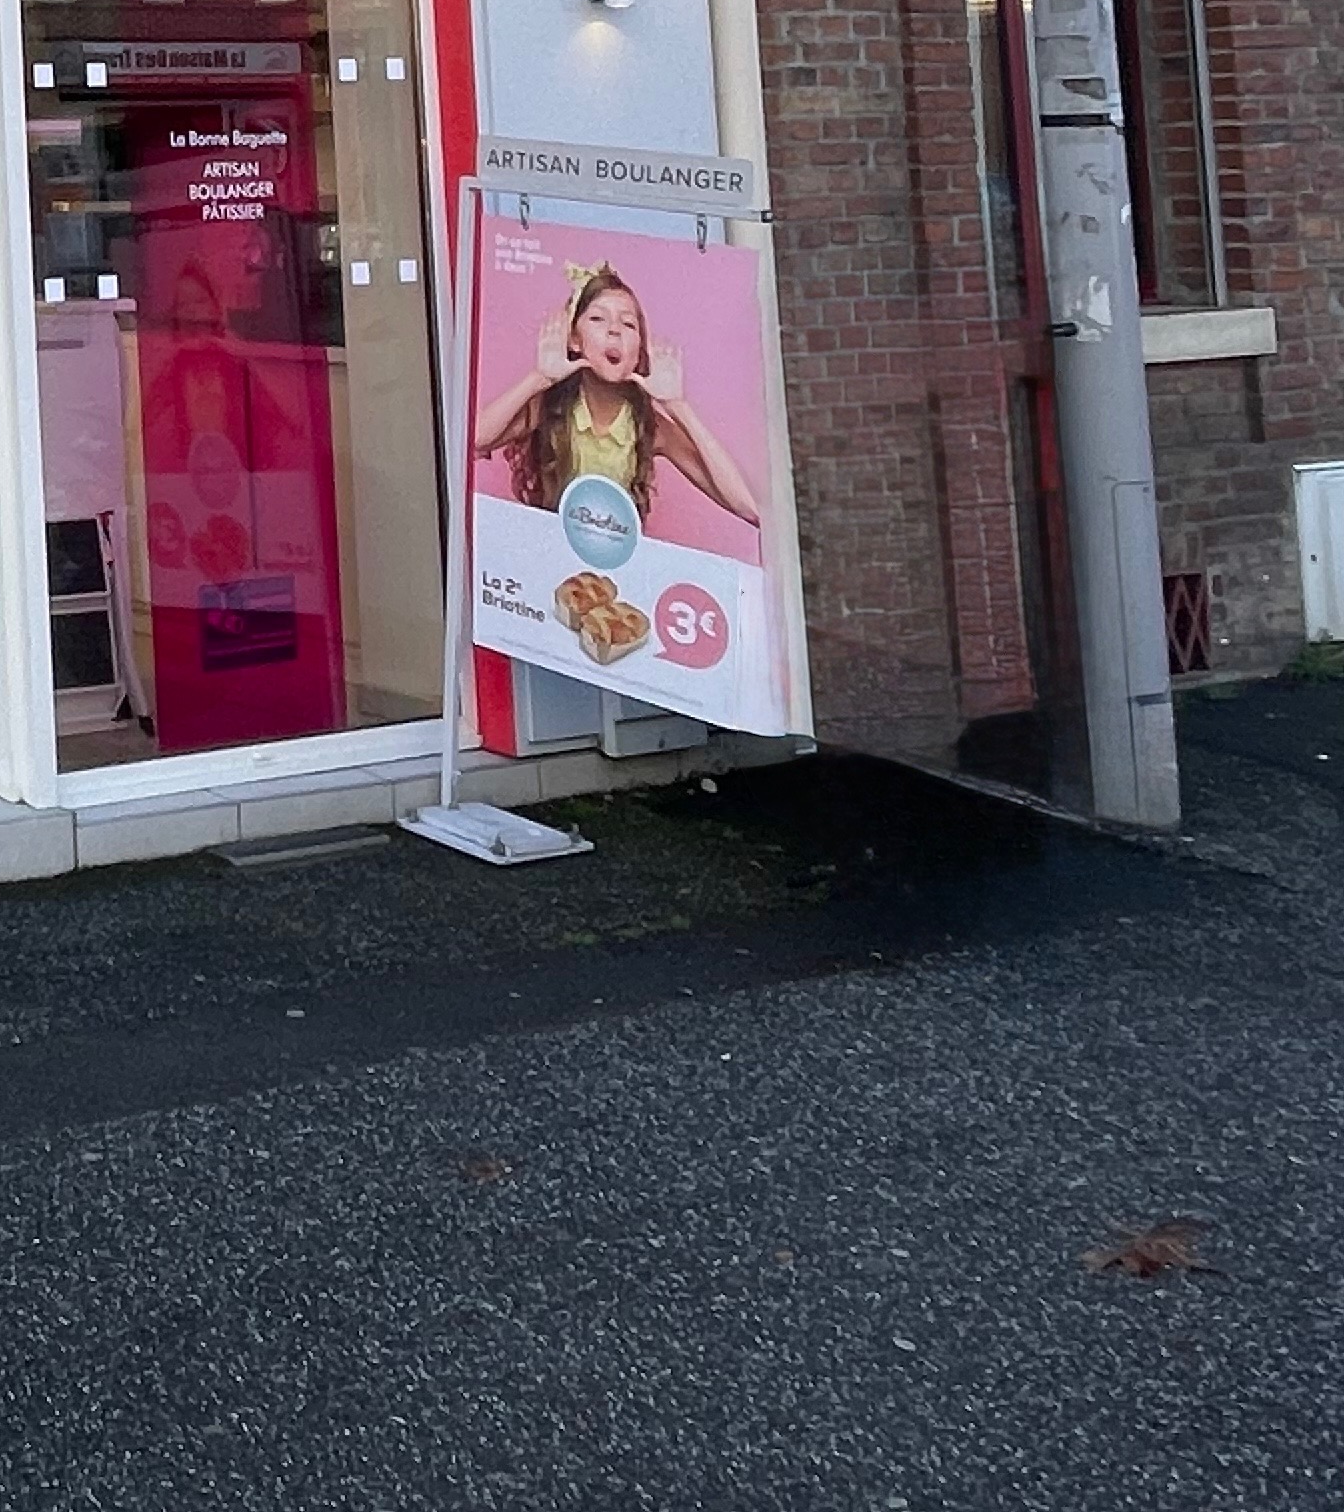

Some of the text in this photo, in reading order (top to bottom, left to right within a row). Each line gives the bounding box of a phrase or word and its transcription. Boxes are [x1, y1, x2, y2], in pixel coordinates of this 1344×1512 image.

[169, 130, 186, 148] La
[188, 130, 230, 148] Bonne
[202, 161, 260, 178] ARTISAN
[486, 148, 745, 193] ARTISAN BOULANGER
[188, 180, 275, 200] BOULANGER
[482, 570, 503, 590] La
[482, 588, 546, 623] Briotine
[666, 601, 718, 645] 3€
